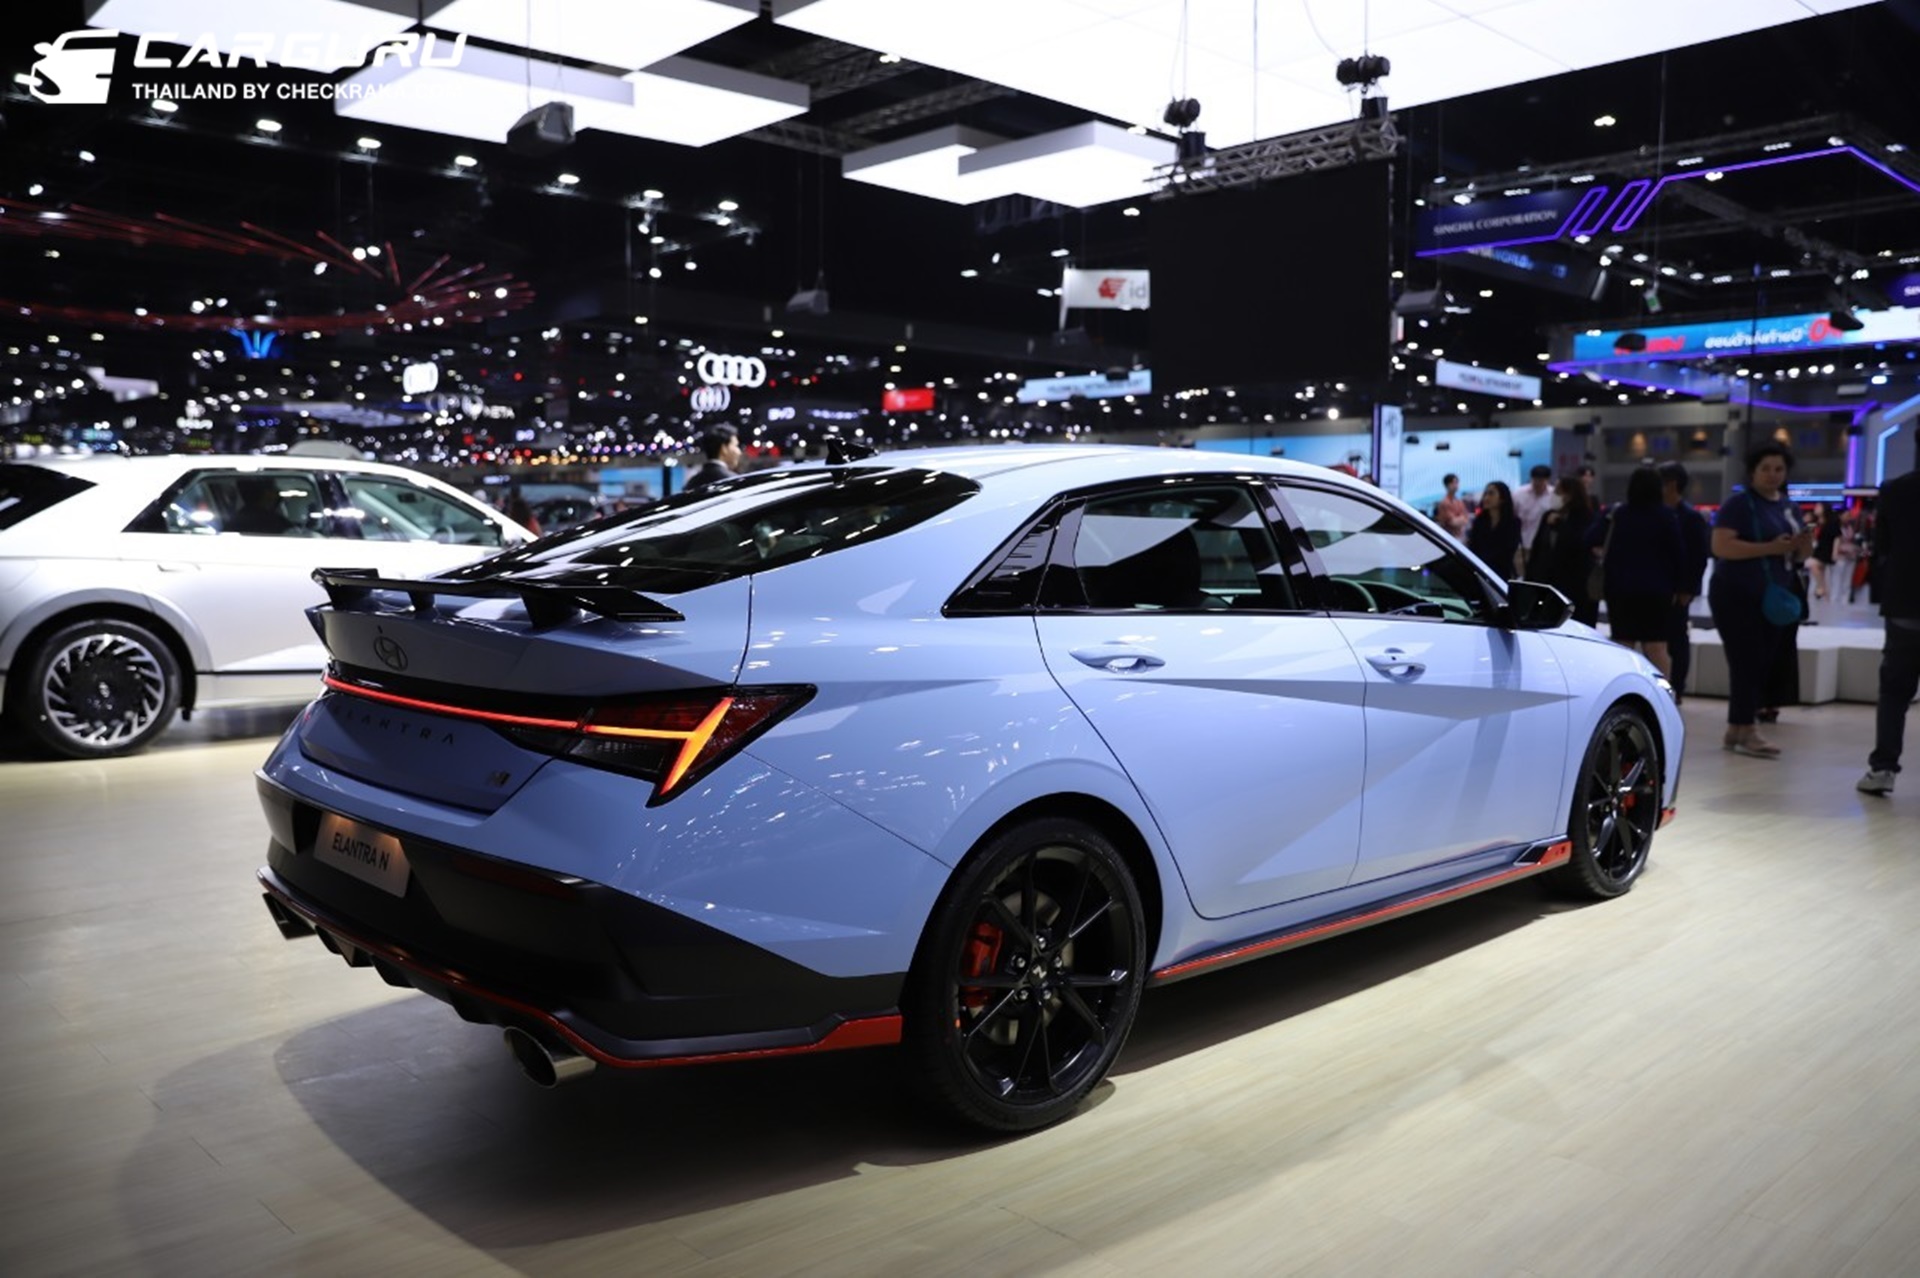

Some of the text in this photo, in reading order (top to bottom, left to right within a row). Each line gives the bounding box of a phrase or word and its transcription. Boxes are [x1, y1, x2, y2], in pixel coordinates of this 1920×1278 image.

[1475, 210, 1558, 230] CORPORATION
[332, 705, 455, 745] ELANTRA
[332, 832, 391, 872] ELANTRA N
